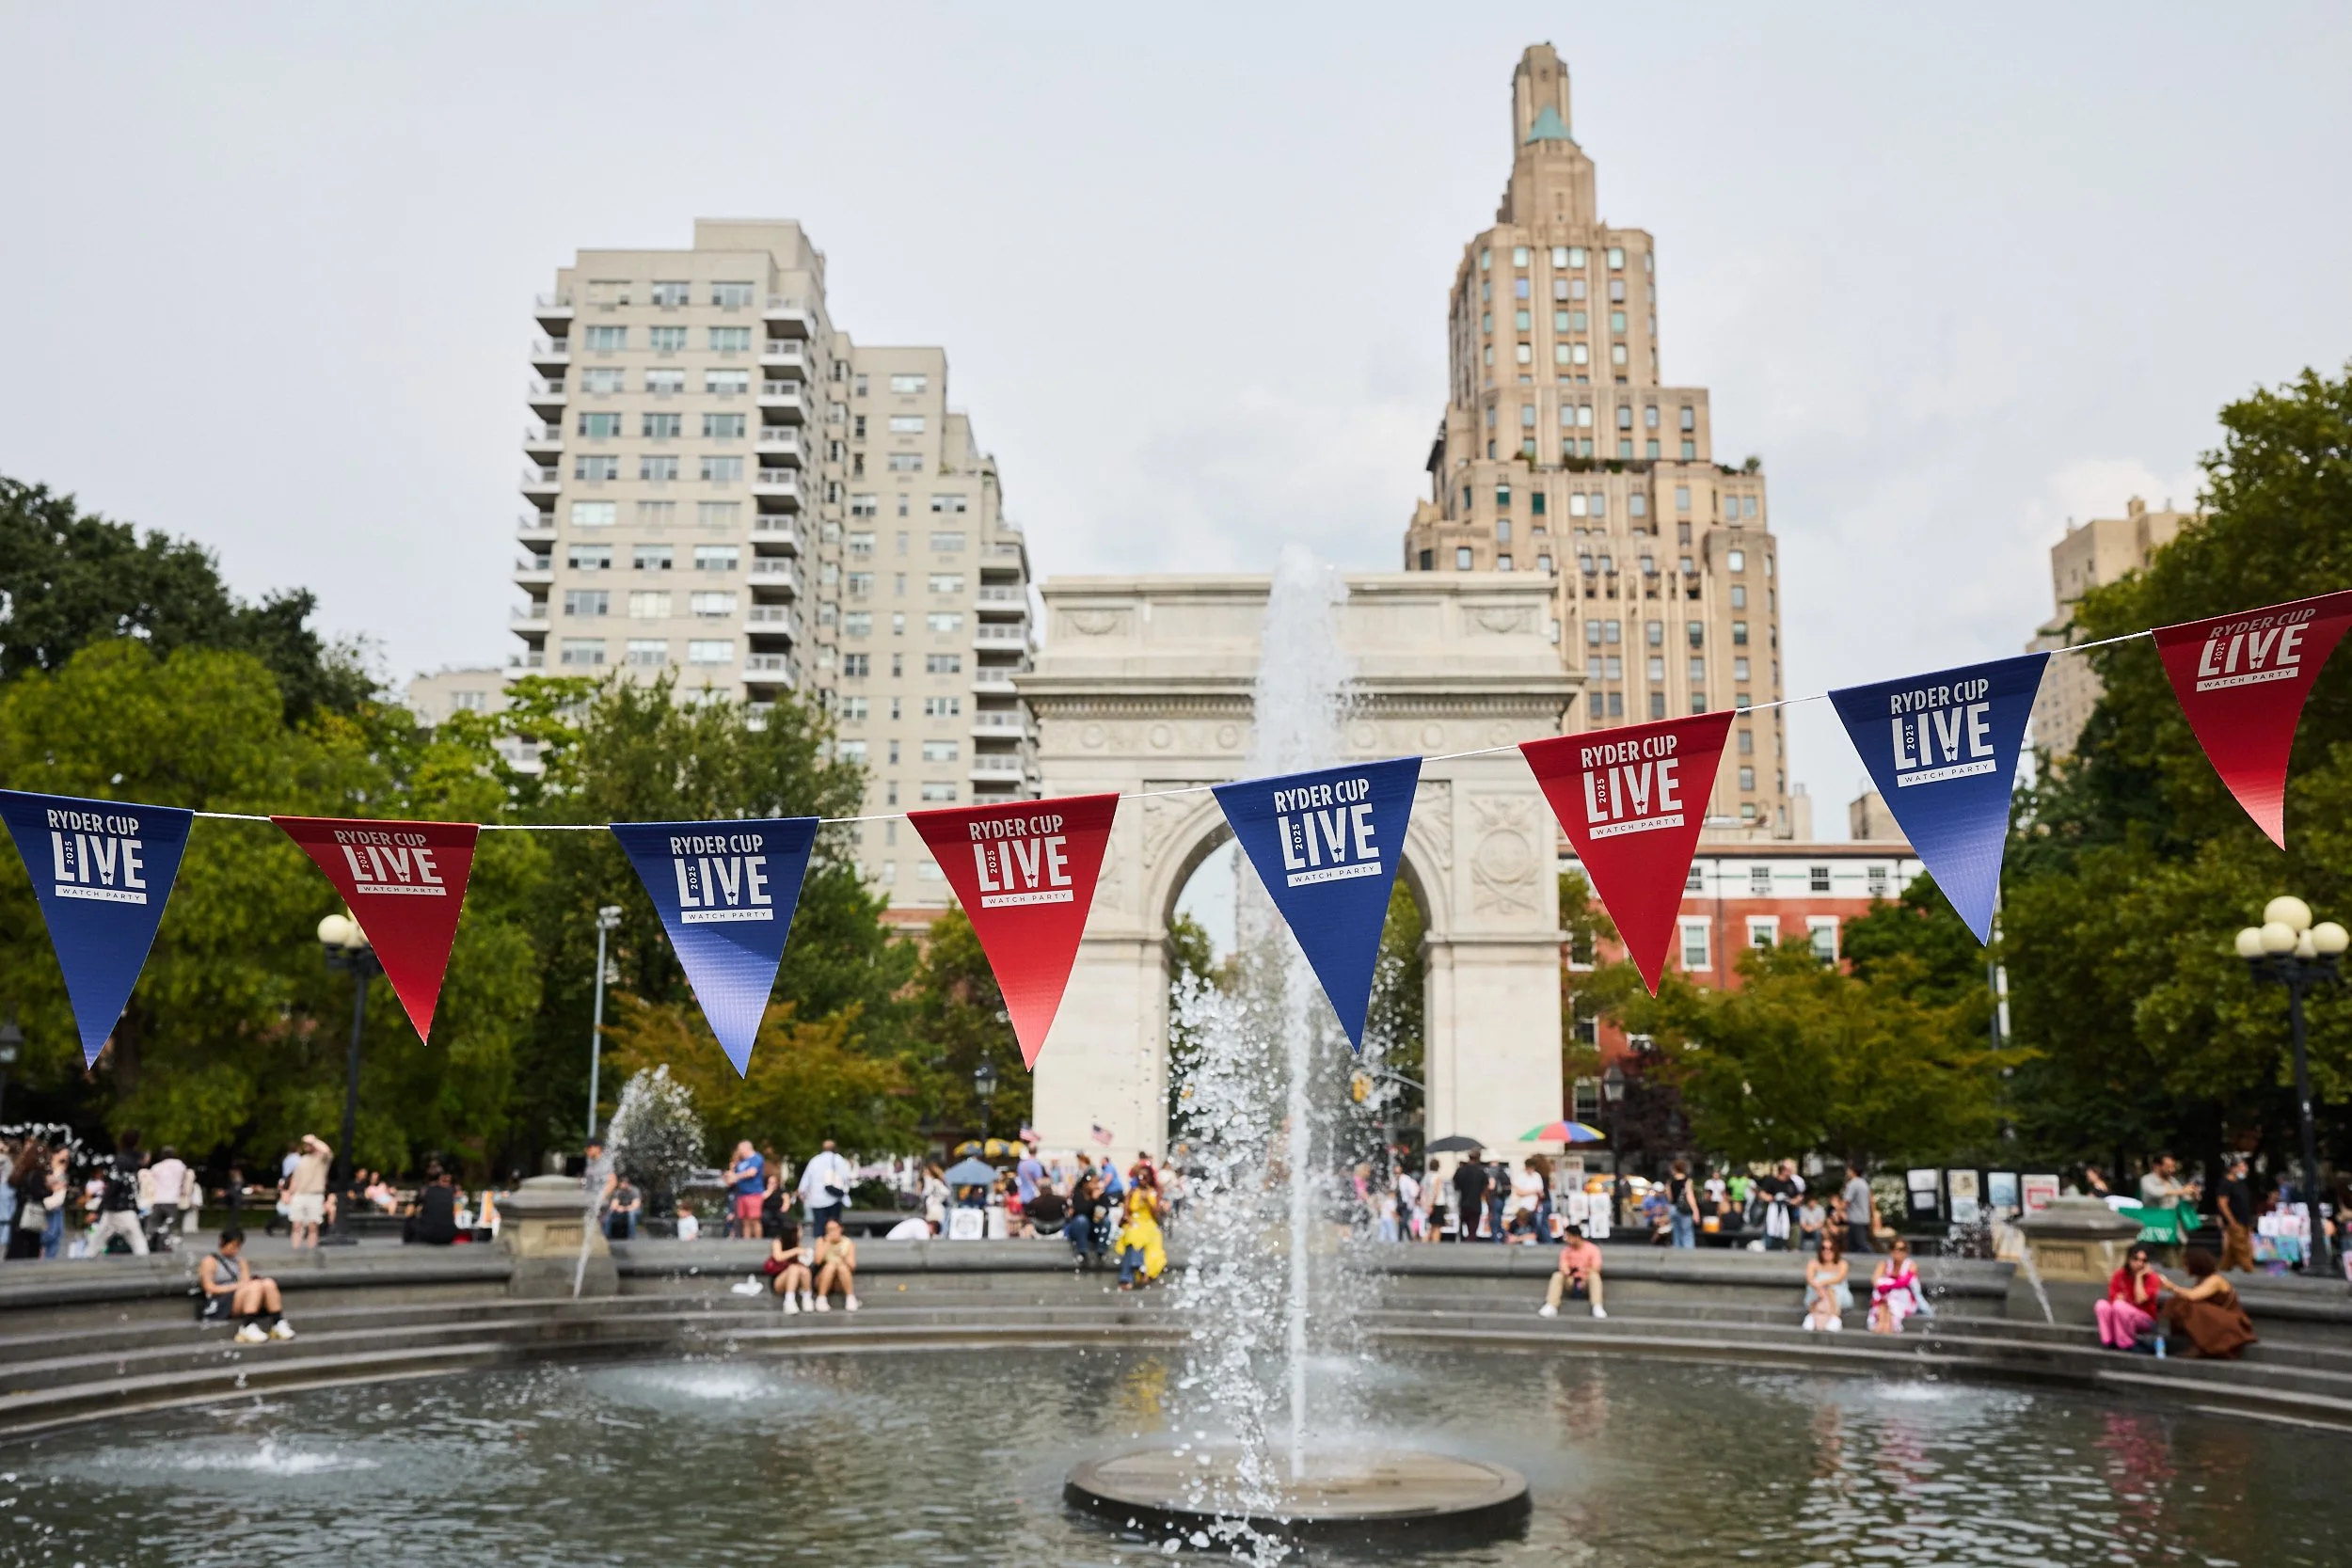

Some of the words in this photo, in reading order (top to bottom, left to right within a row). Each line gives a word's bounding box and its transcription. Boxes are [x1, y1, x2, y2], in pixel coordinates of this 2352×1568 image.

[2209, 616, 2274, 639] RYDER
[2277, 608, 2316, 626] CUP
[2197, 623, 2310, 678] LIVE
[2214, 641, 2226, 661] 2025
[2203, 677, 2245, 689] WATCH
[2252, 670, 2292, 681] PARTY
[1890, 686, 1950, 715] RYDER
[1953, 678, 1989, 703] CUP
[1891, 702, 1994, 770] LIVE
[1905, 724, 1915, 750] 2025
[1581, 740, 1640, 768] RYDER
[1643, 735, 1677, 759] CUP
[1904, 772, 1945, 783] WATCH
[1951, 764, 1989, 775] PARTY
[1273, 784, 1334, 813] RYDER
[1335, 778, 1370, 803] CUP
[1582, 757, 1683, 824] LIVE
[1597, 778, 1607, 803] 2025
[46, 809, 104, 833] RYDER
[105, 816, 139, 836] CUP
[968, 817, 1028, 841] RYDER
[1029, 815, 1063, 835] CUP
[1597, 824, 1634, 835] WATCH
[1641, 817, 1677, 829] PARTY
[333, 830, 392, 846] RYDER
[394, 832, 427, 847] CUP
[669, 835, 728, 855] RYDER
[729, 834, 763, 853] CUP
[1278, 802, 1380, 871] LIVE
[1292, 823, 1303, 850] 2025
[51, 831, 147, 889] LIVE
[64, 841, 74, 865] 2025
[341, 845, 444, 884] LIVE
[357, 851, 370, 869] 2025
[973, 835, 1073, 892] LIVE
[987, 849, 998, 874] 2025
[674, 855, 772, 908] LIVE
[688, 865, 699, 890] 2025
[1294, 872, 1332, 882] WATCH
[1339, 865, 1375, 876] PARTY
[62, 888, 100, 896] WATCH
[106, 892, 140, 901] PARTY
[1032, 893, 1067, 901] PARTY
